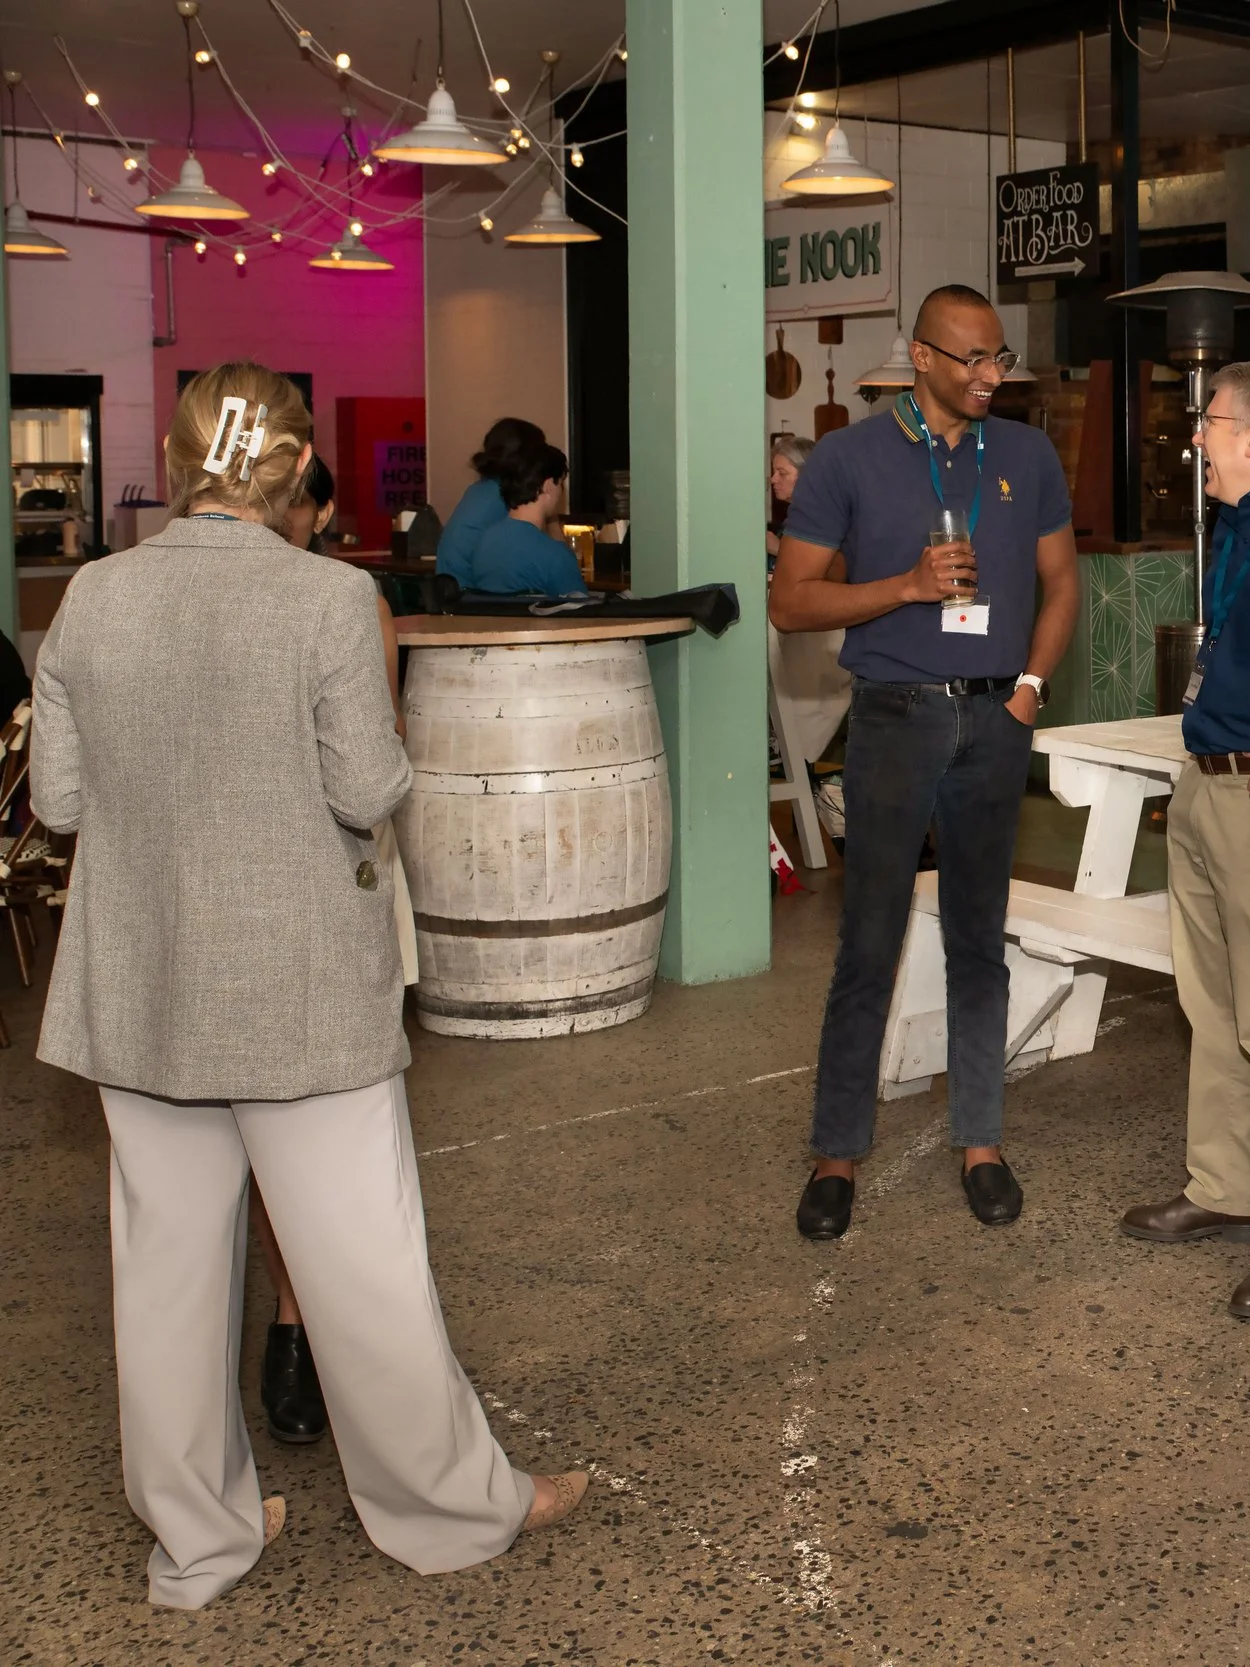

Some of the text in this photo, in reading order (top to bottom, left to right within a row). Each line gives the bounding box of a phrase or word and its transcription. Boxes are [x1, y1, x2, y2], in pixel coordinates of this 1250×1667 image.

[1000, 171, 1084, 214] ORDER FOOD
[800, 221, 882, 284] NOOK
[998, 210, 1093, 264] AT BAR
